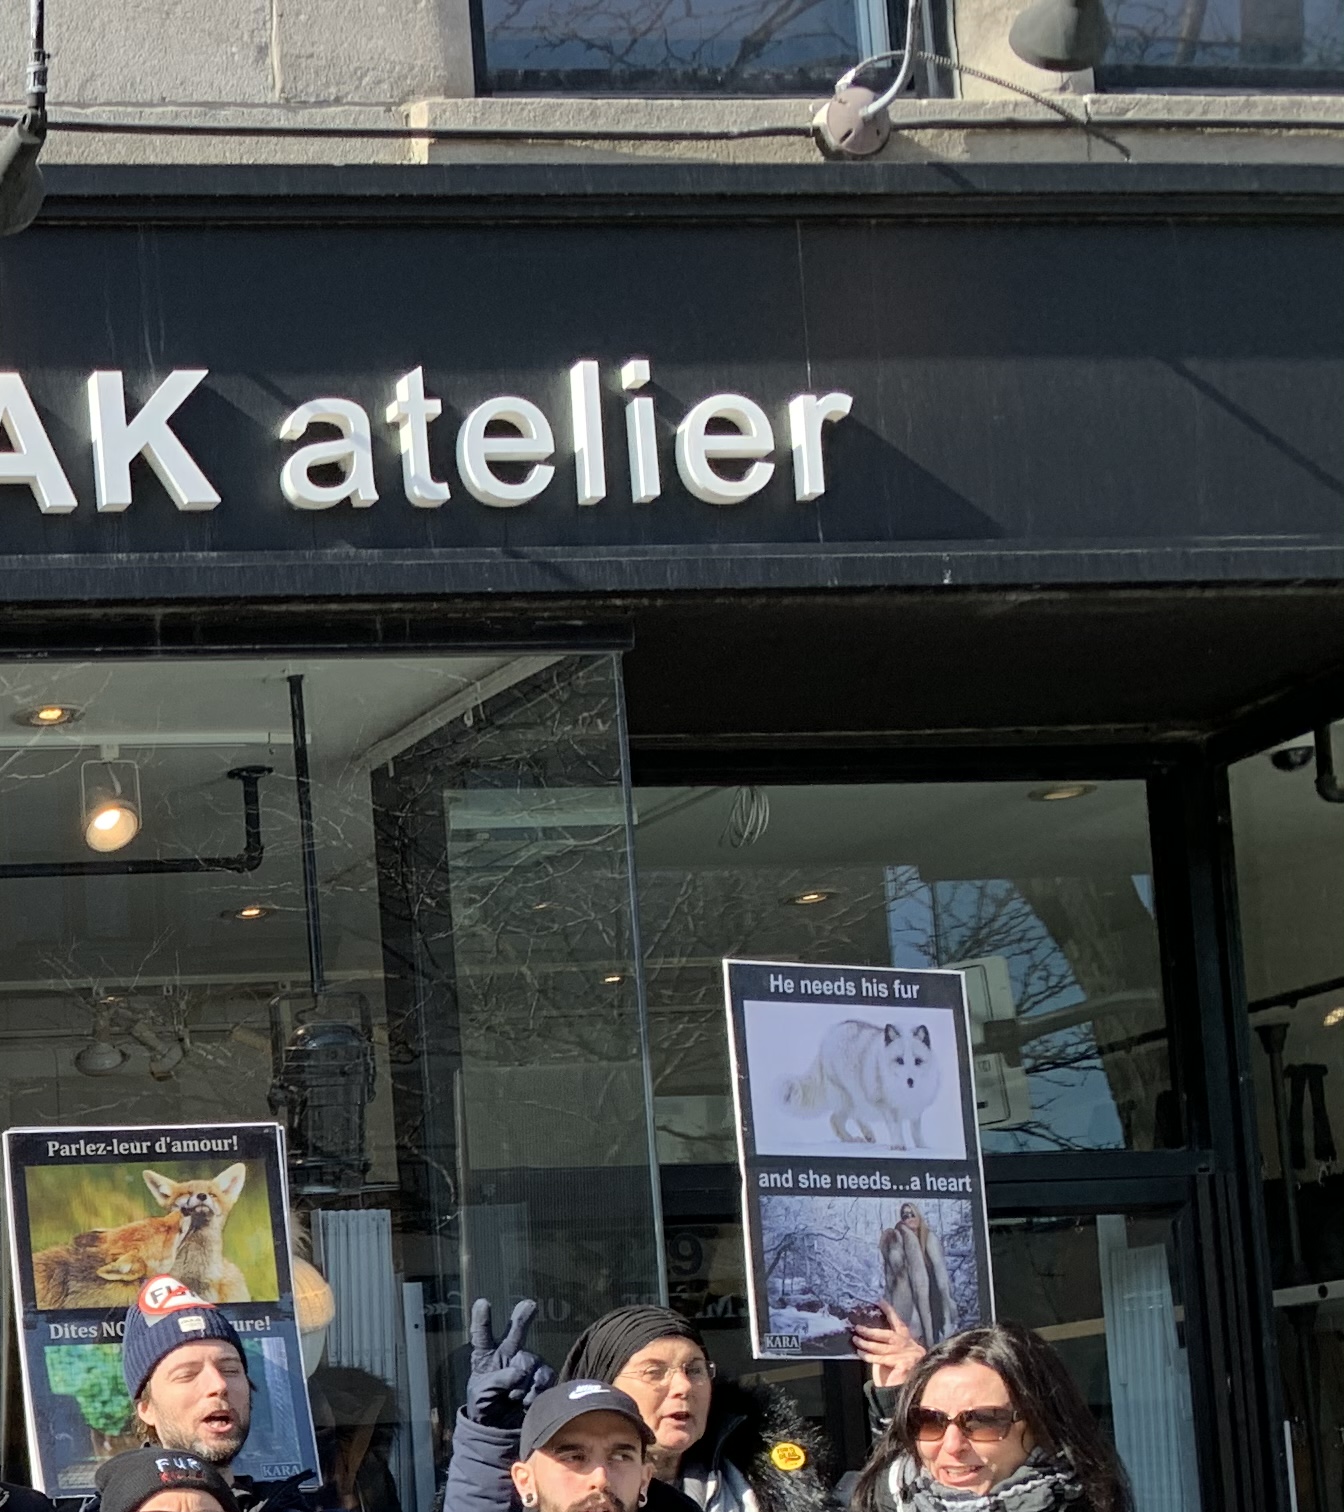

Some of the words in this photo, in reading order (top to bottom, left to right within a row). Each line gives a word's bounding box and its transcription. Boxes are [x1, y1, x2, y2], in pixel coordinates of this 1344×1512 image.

[278, 358, 853, 510] atelier
[769, 974, 795, 994] He
[800, 977, 856, 997] needs
[862, 978, 888, 998] his
[893, 979, 920, 999] fur
[47, 1138, 150, 1157] Parlez-leur
[154, 1135, 239, 1154] d'amour!
[759, 1170, 794, 1189] and
[798, 1170, 832, 1189] she
[926, 1174, 972, 1193] heart
[49, 1321, 98, 1340] Dites
[101, 1322, 126, 1339] NO
[232, 1315, 271, 1332] ure!
[765, 1335, 799, 1350] KARA
[155, 1457, 202, 1473] FUR
[263, 1464, 301, 1478] KARA
